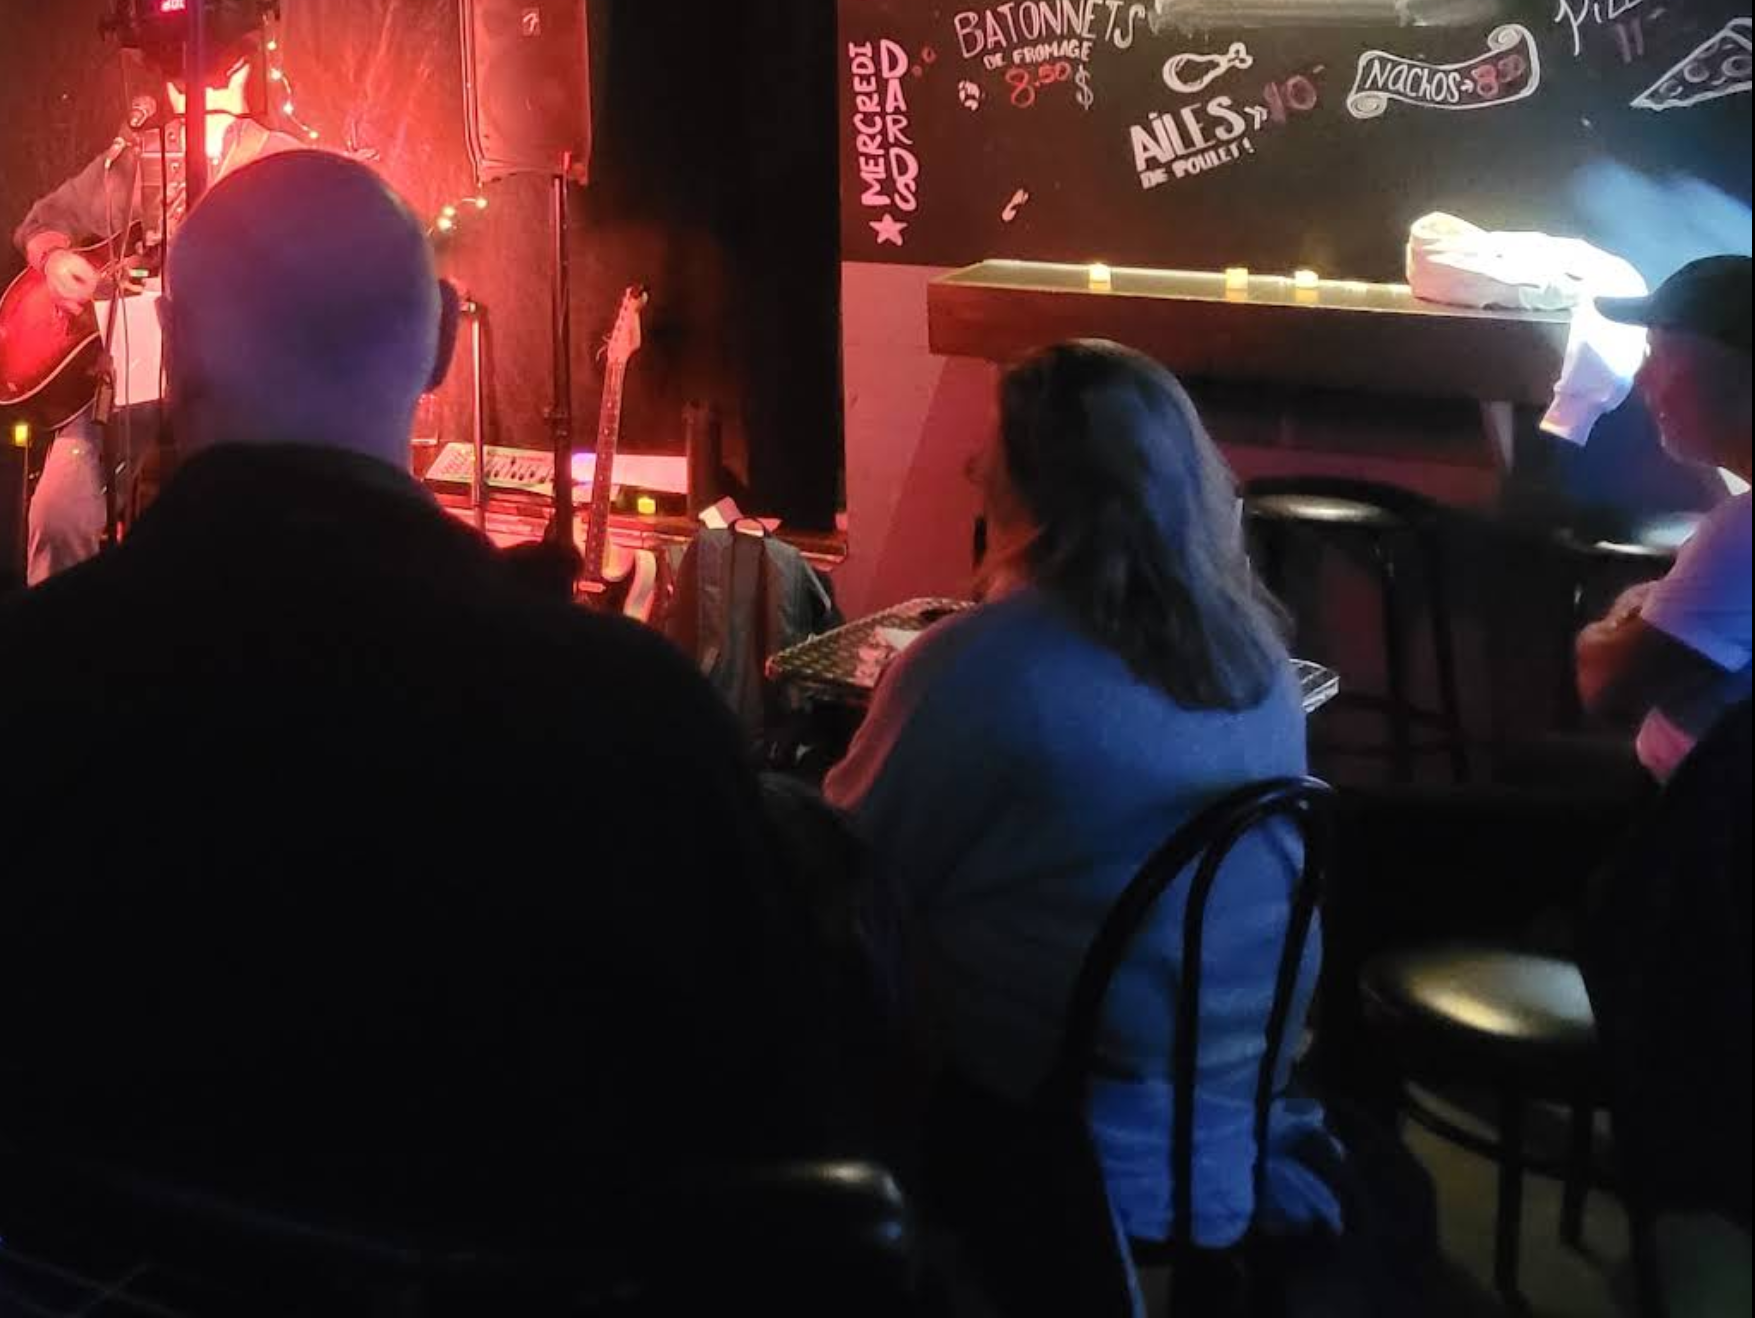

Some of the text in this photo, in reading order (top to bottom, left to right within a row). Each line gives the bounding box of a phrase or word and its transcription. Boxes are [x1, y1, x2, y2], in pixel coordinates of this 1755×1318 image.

[983, 39, 1092, 70] DE FROMAGE
[848, 42, 891, 206] MERCREDI
[880, 39, 919, 211] DARDS
[1140, 168, 1167, 189] DE
